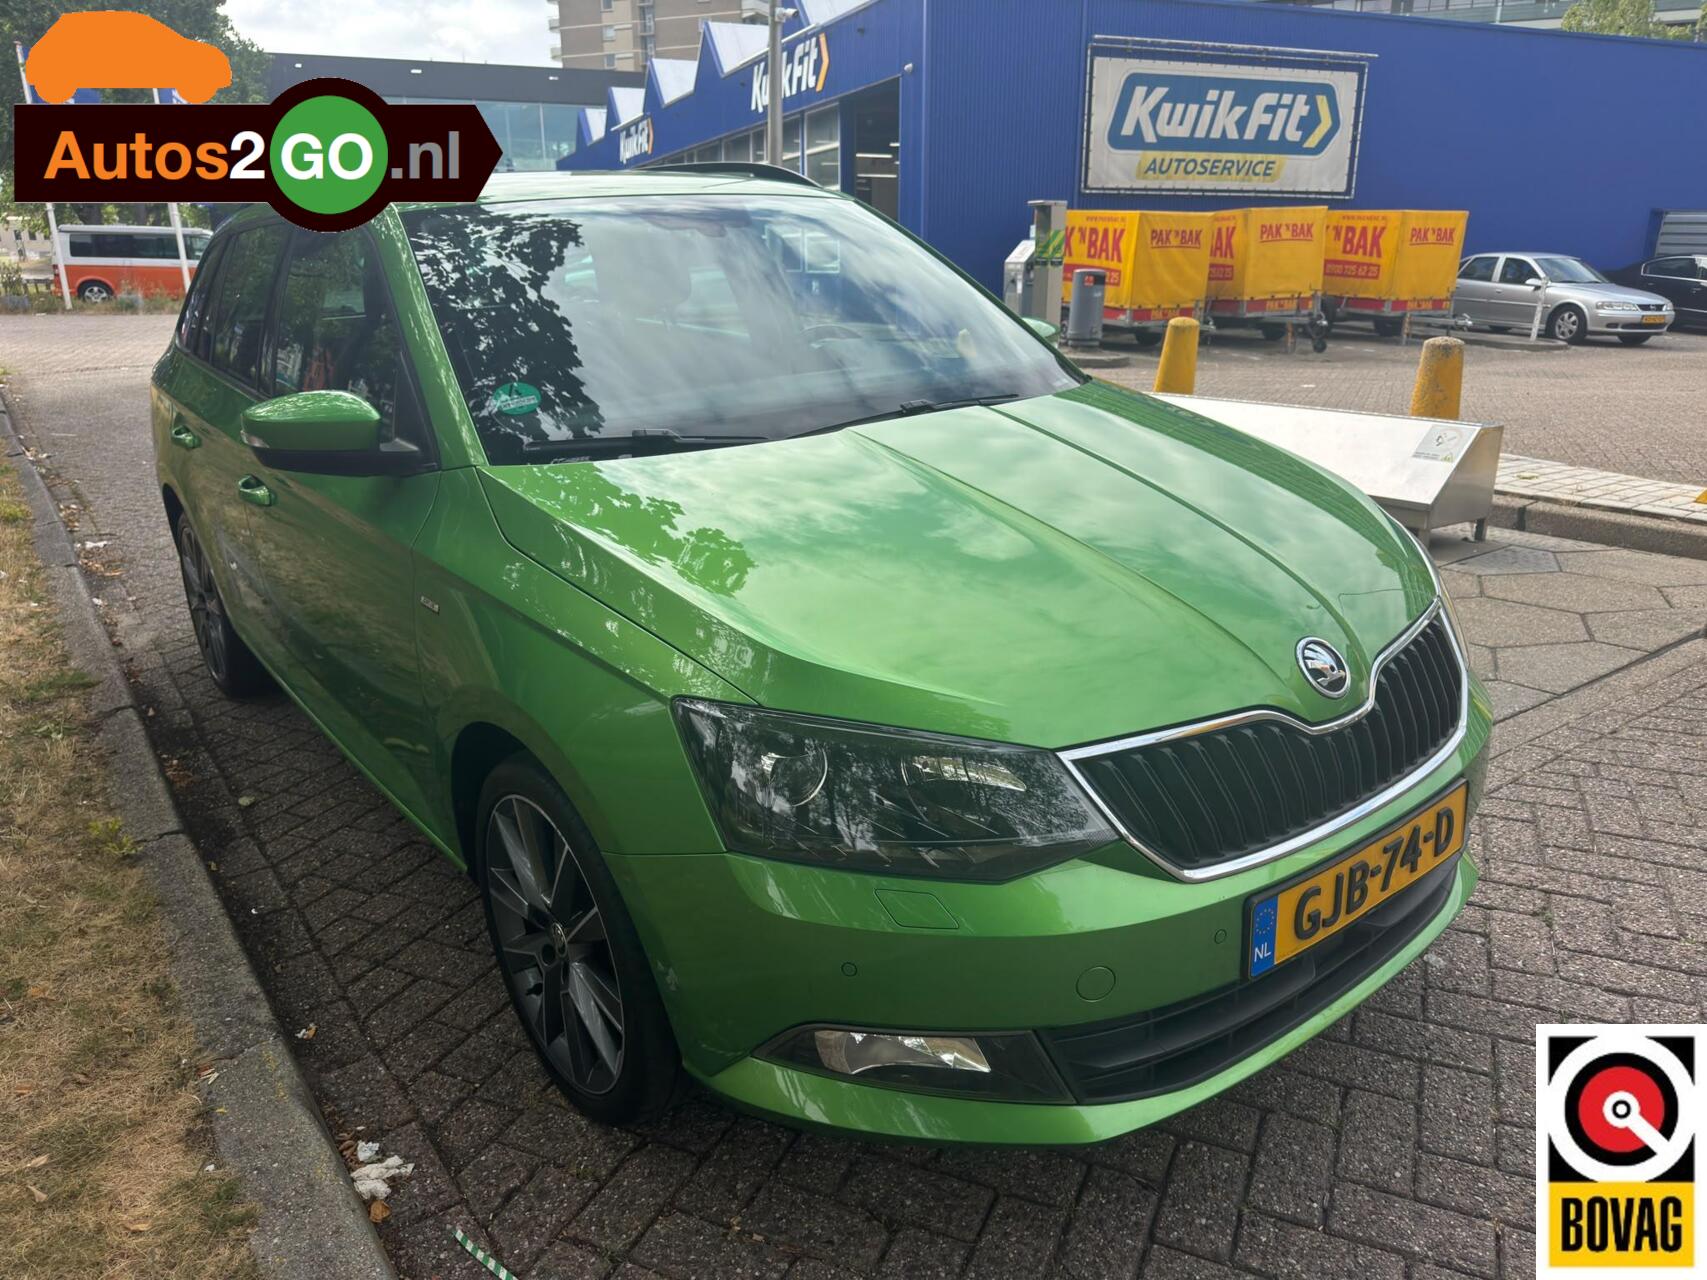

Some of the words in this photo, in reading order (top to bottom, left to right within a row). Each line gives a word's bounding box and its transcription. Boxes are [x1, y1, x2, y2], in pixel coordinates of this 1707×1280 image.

[1144, 156, 1277, 177] AUTOSERVICE
[1151, 229, 1171, 245] PAK
[1180, 229, 1202, 246] BAK
[1260, 223, 1282, 241] PAK
[1291, 223, 1313, 240] BAK
[1342, 225, 1387, 260] BAK
[1410, 227, 1430, 242] PAK
[1435, 227, 1456, 243] BAK
[1087, 227, 1126, 263] BAK
[1294, 806, 1455, 941] GJB-74-D
[1253, 942, 1272, 963] NL
